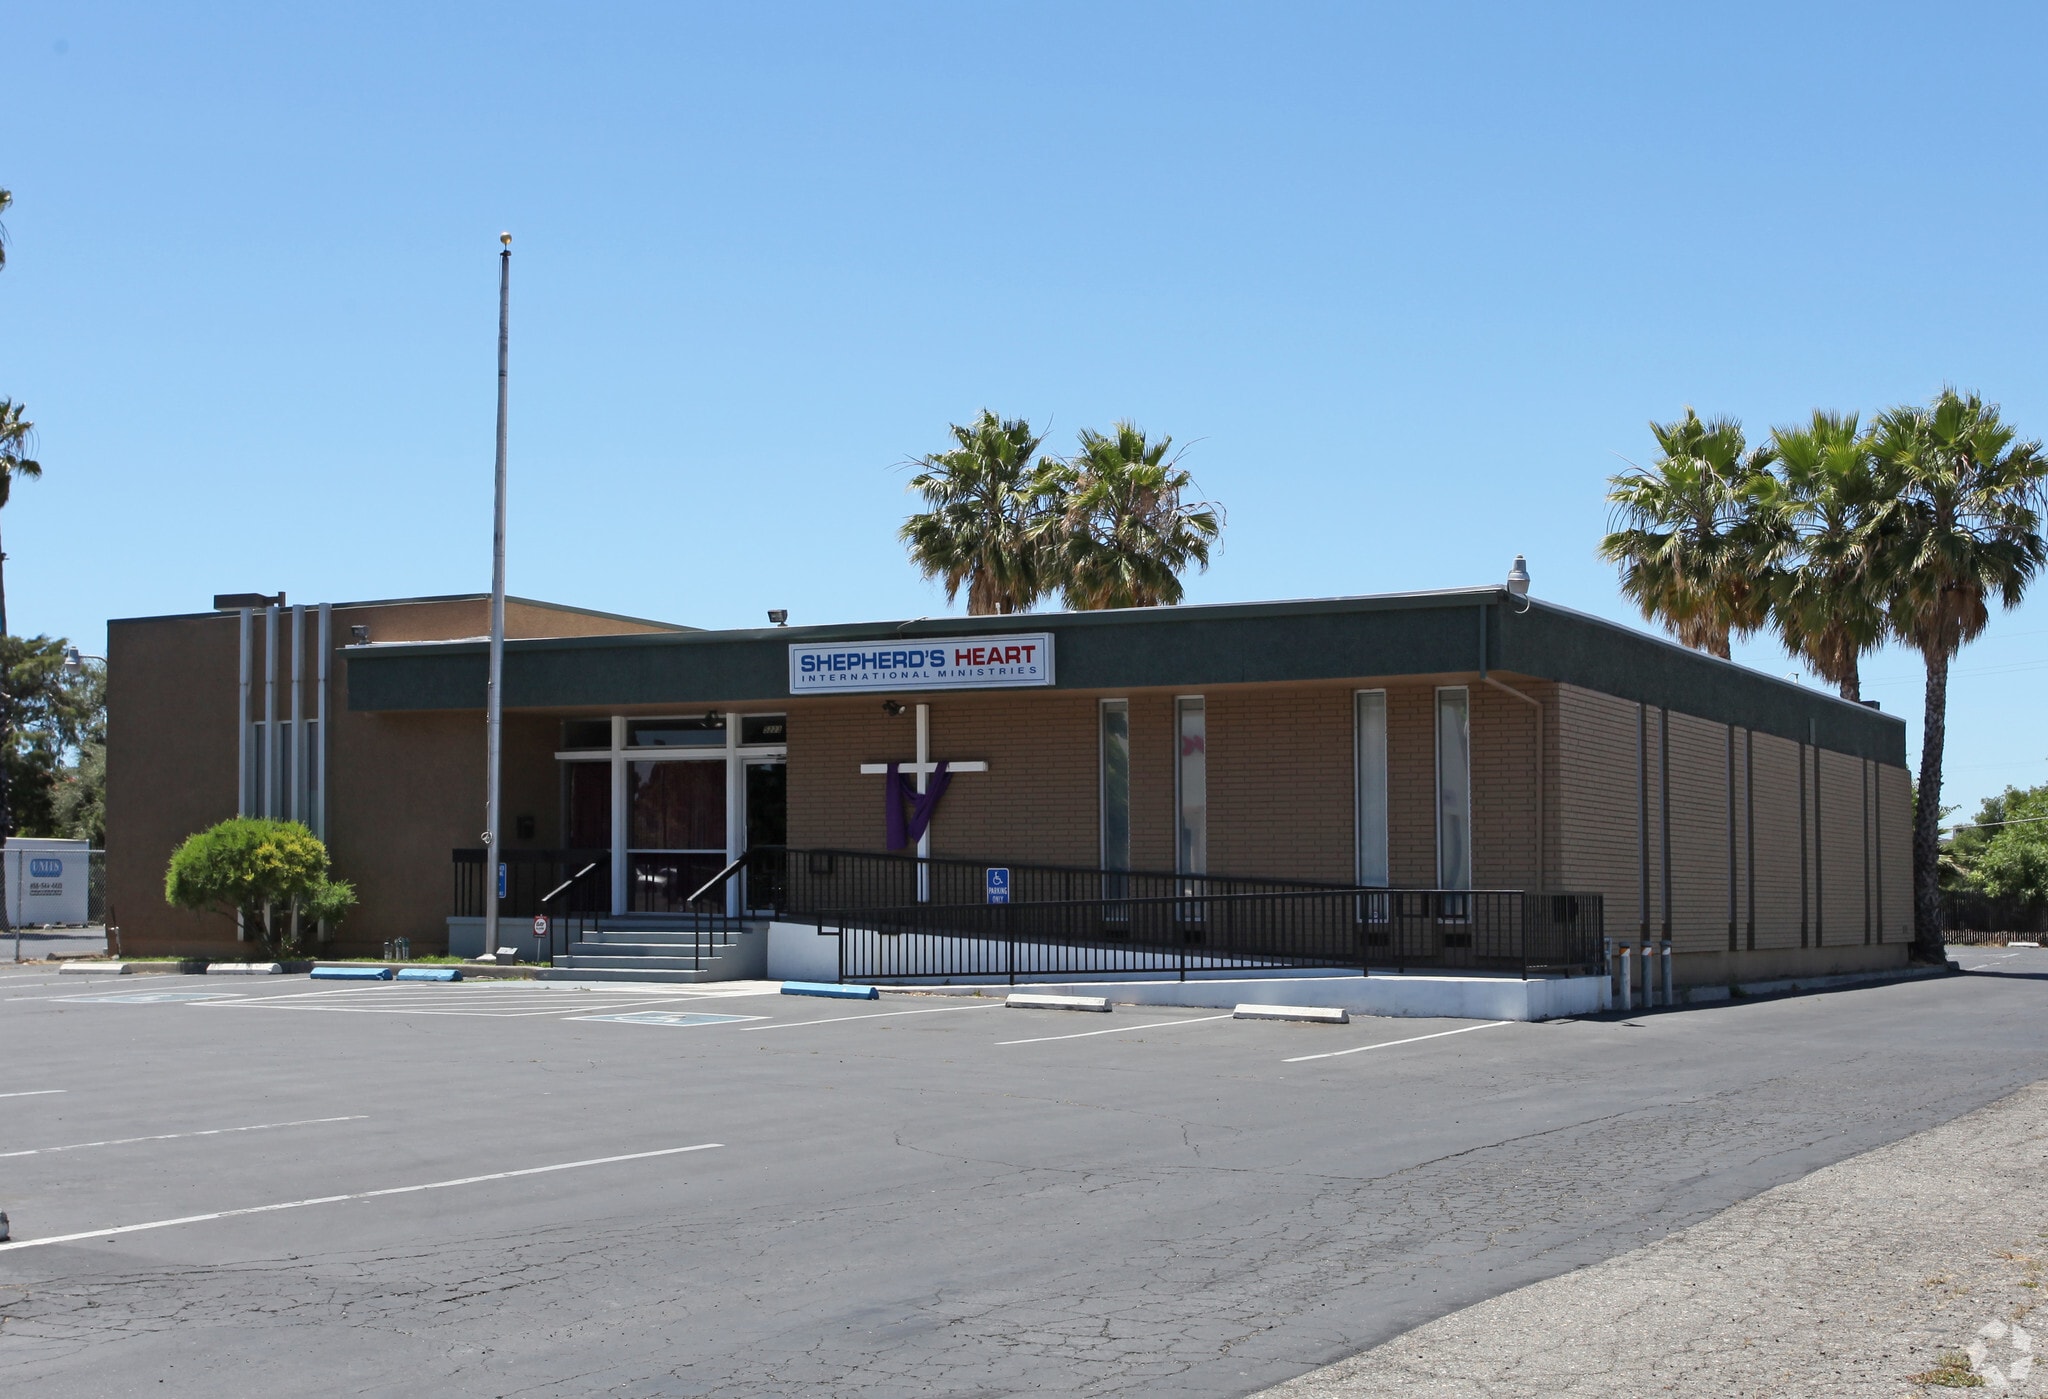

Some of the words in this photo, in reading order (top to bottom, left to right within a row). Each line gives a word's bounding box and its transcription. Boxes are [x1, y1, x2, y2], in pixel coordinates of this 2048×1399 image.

[801, 650, 946, 672] SHEPHERD'S
[955, 645, 1036, 666] HEART
[802, 671, 930, 682] INTERNATIONAL
[938, 666, 1037, 678] MINISTRIES
[989, 887, 1007, 895] PARKING
